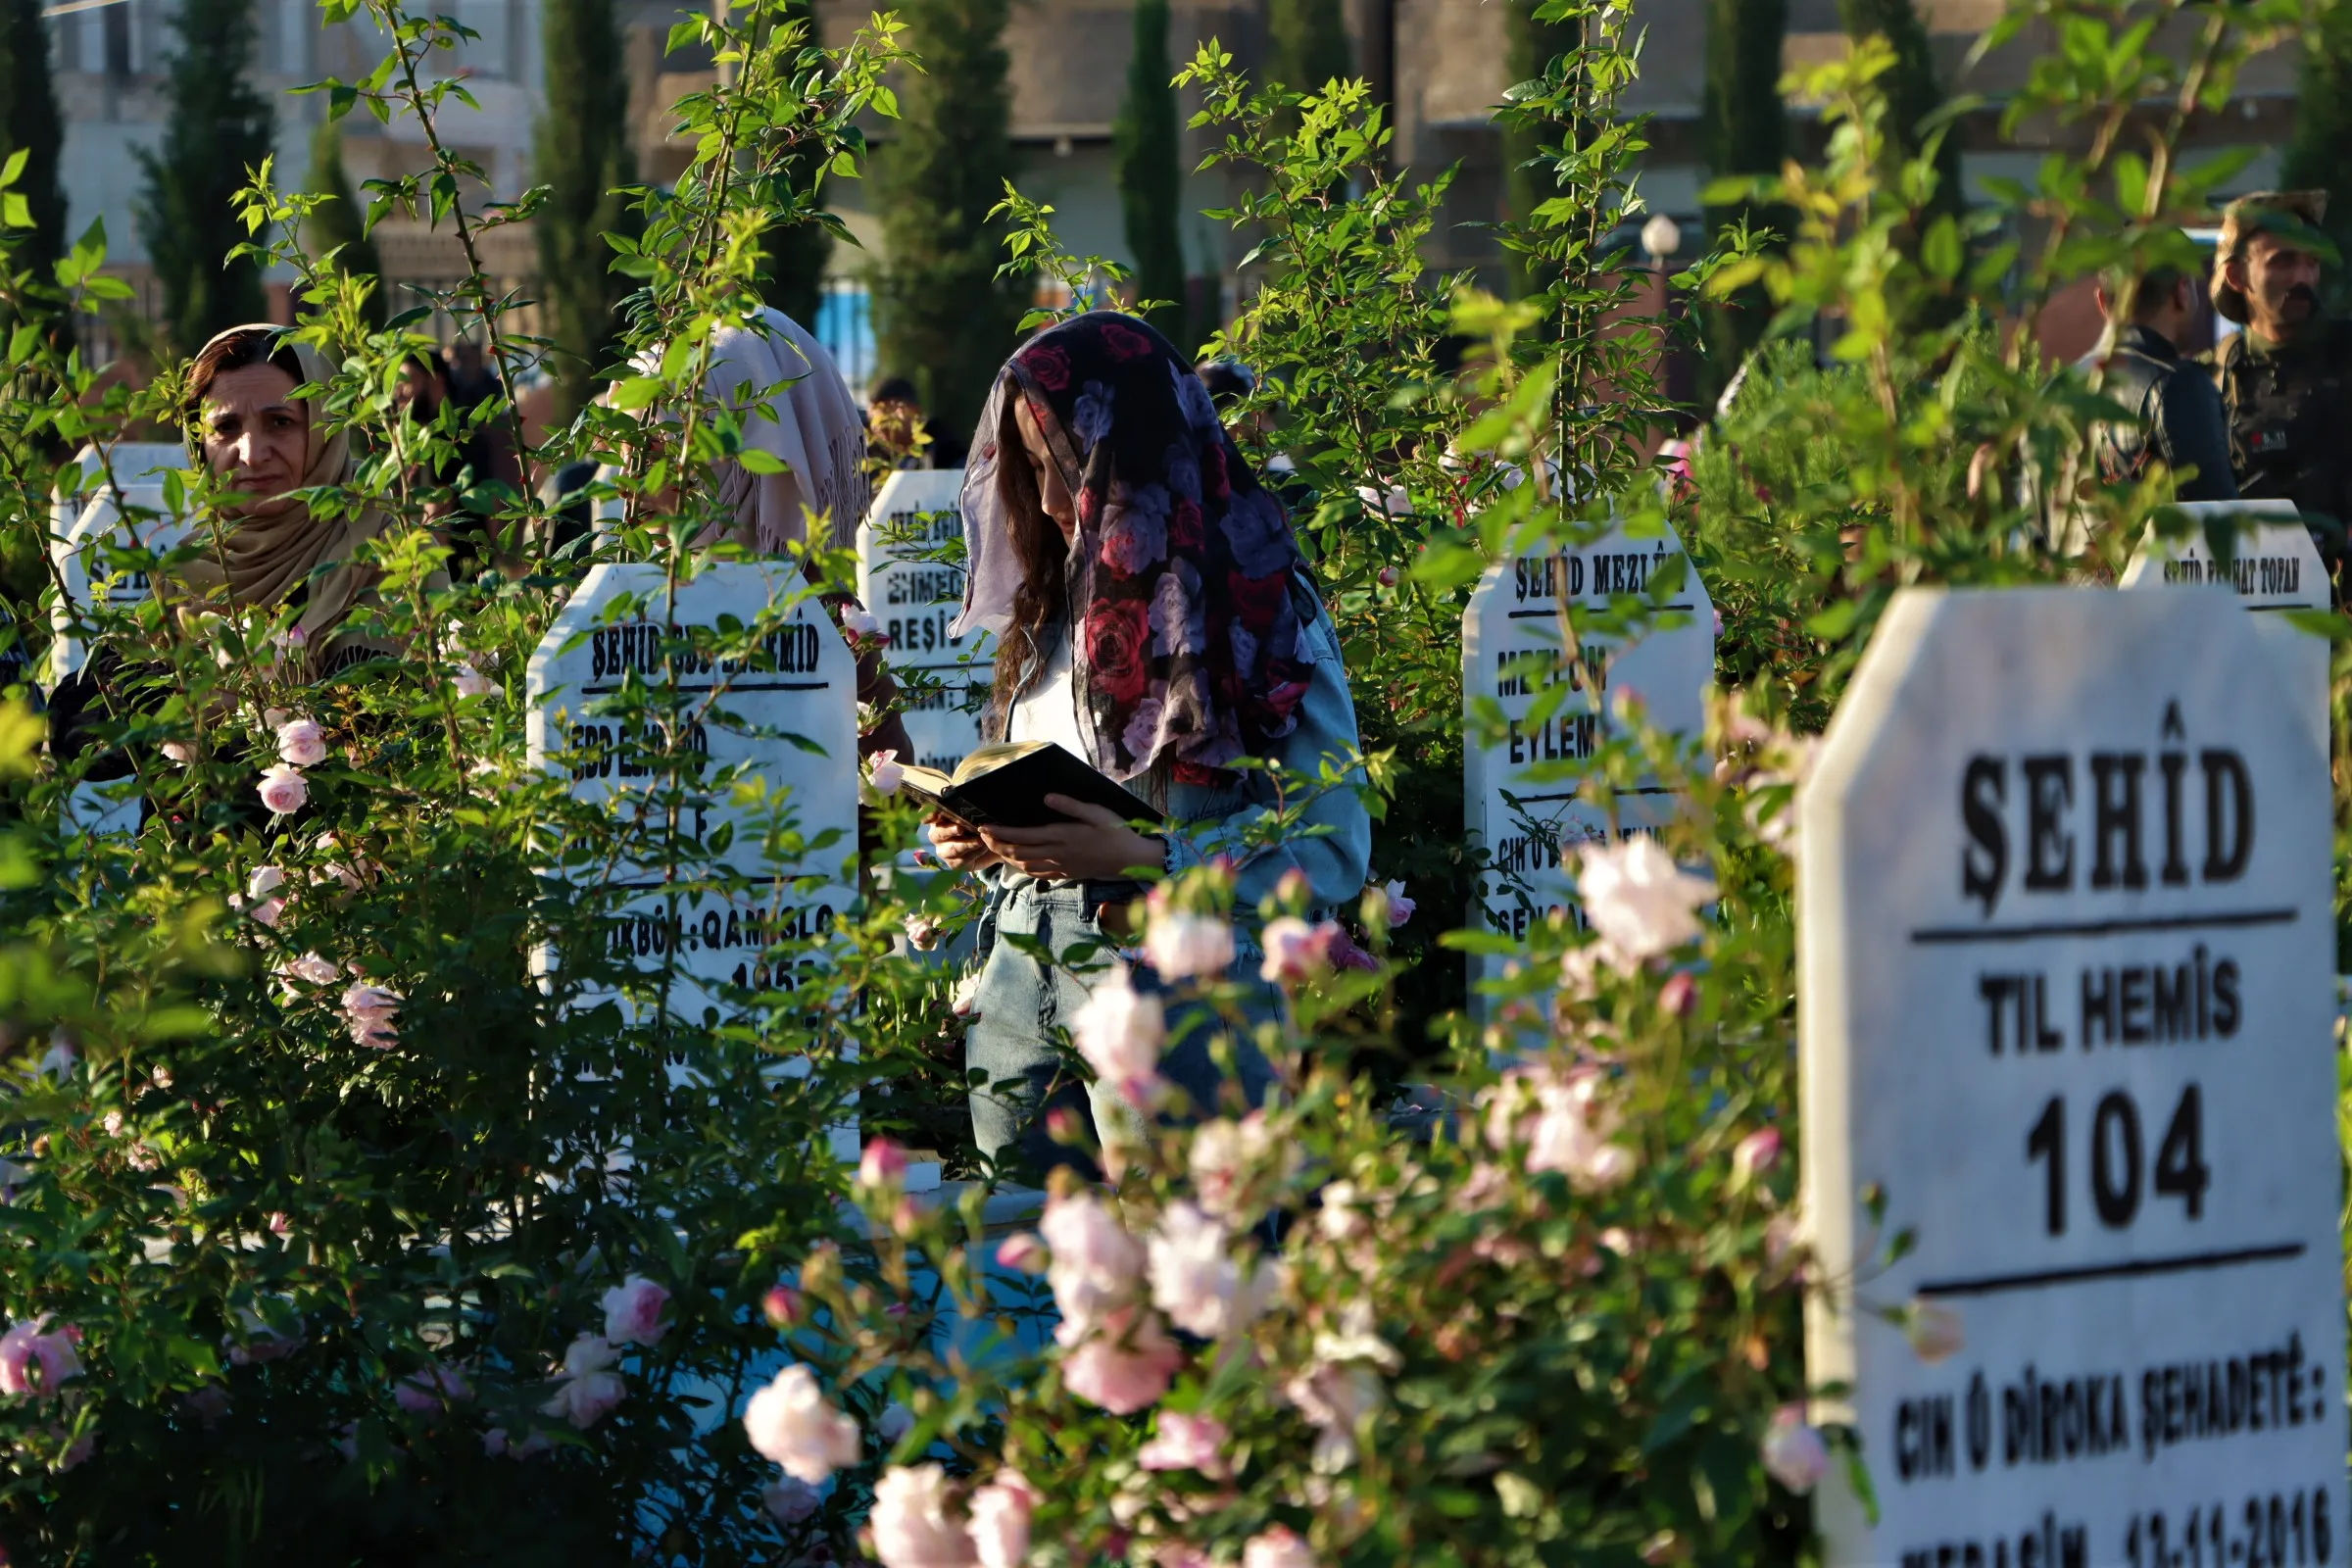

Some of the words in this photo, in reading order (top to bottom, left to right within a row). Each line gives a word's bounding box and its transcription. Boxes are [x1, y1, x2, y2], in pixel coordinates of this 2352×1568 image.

[1961, 697, 2256, 919] ŞEHÎD
[1980, 968, 2064, 1056] TIL
[2025, 1082, 2211, 1238] 104
